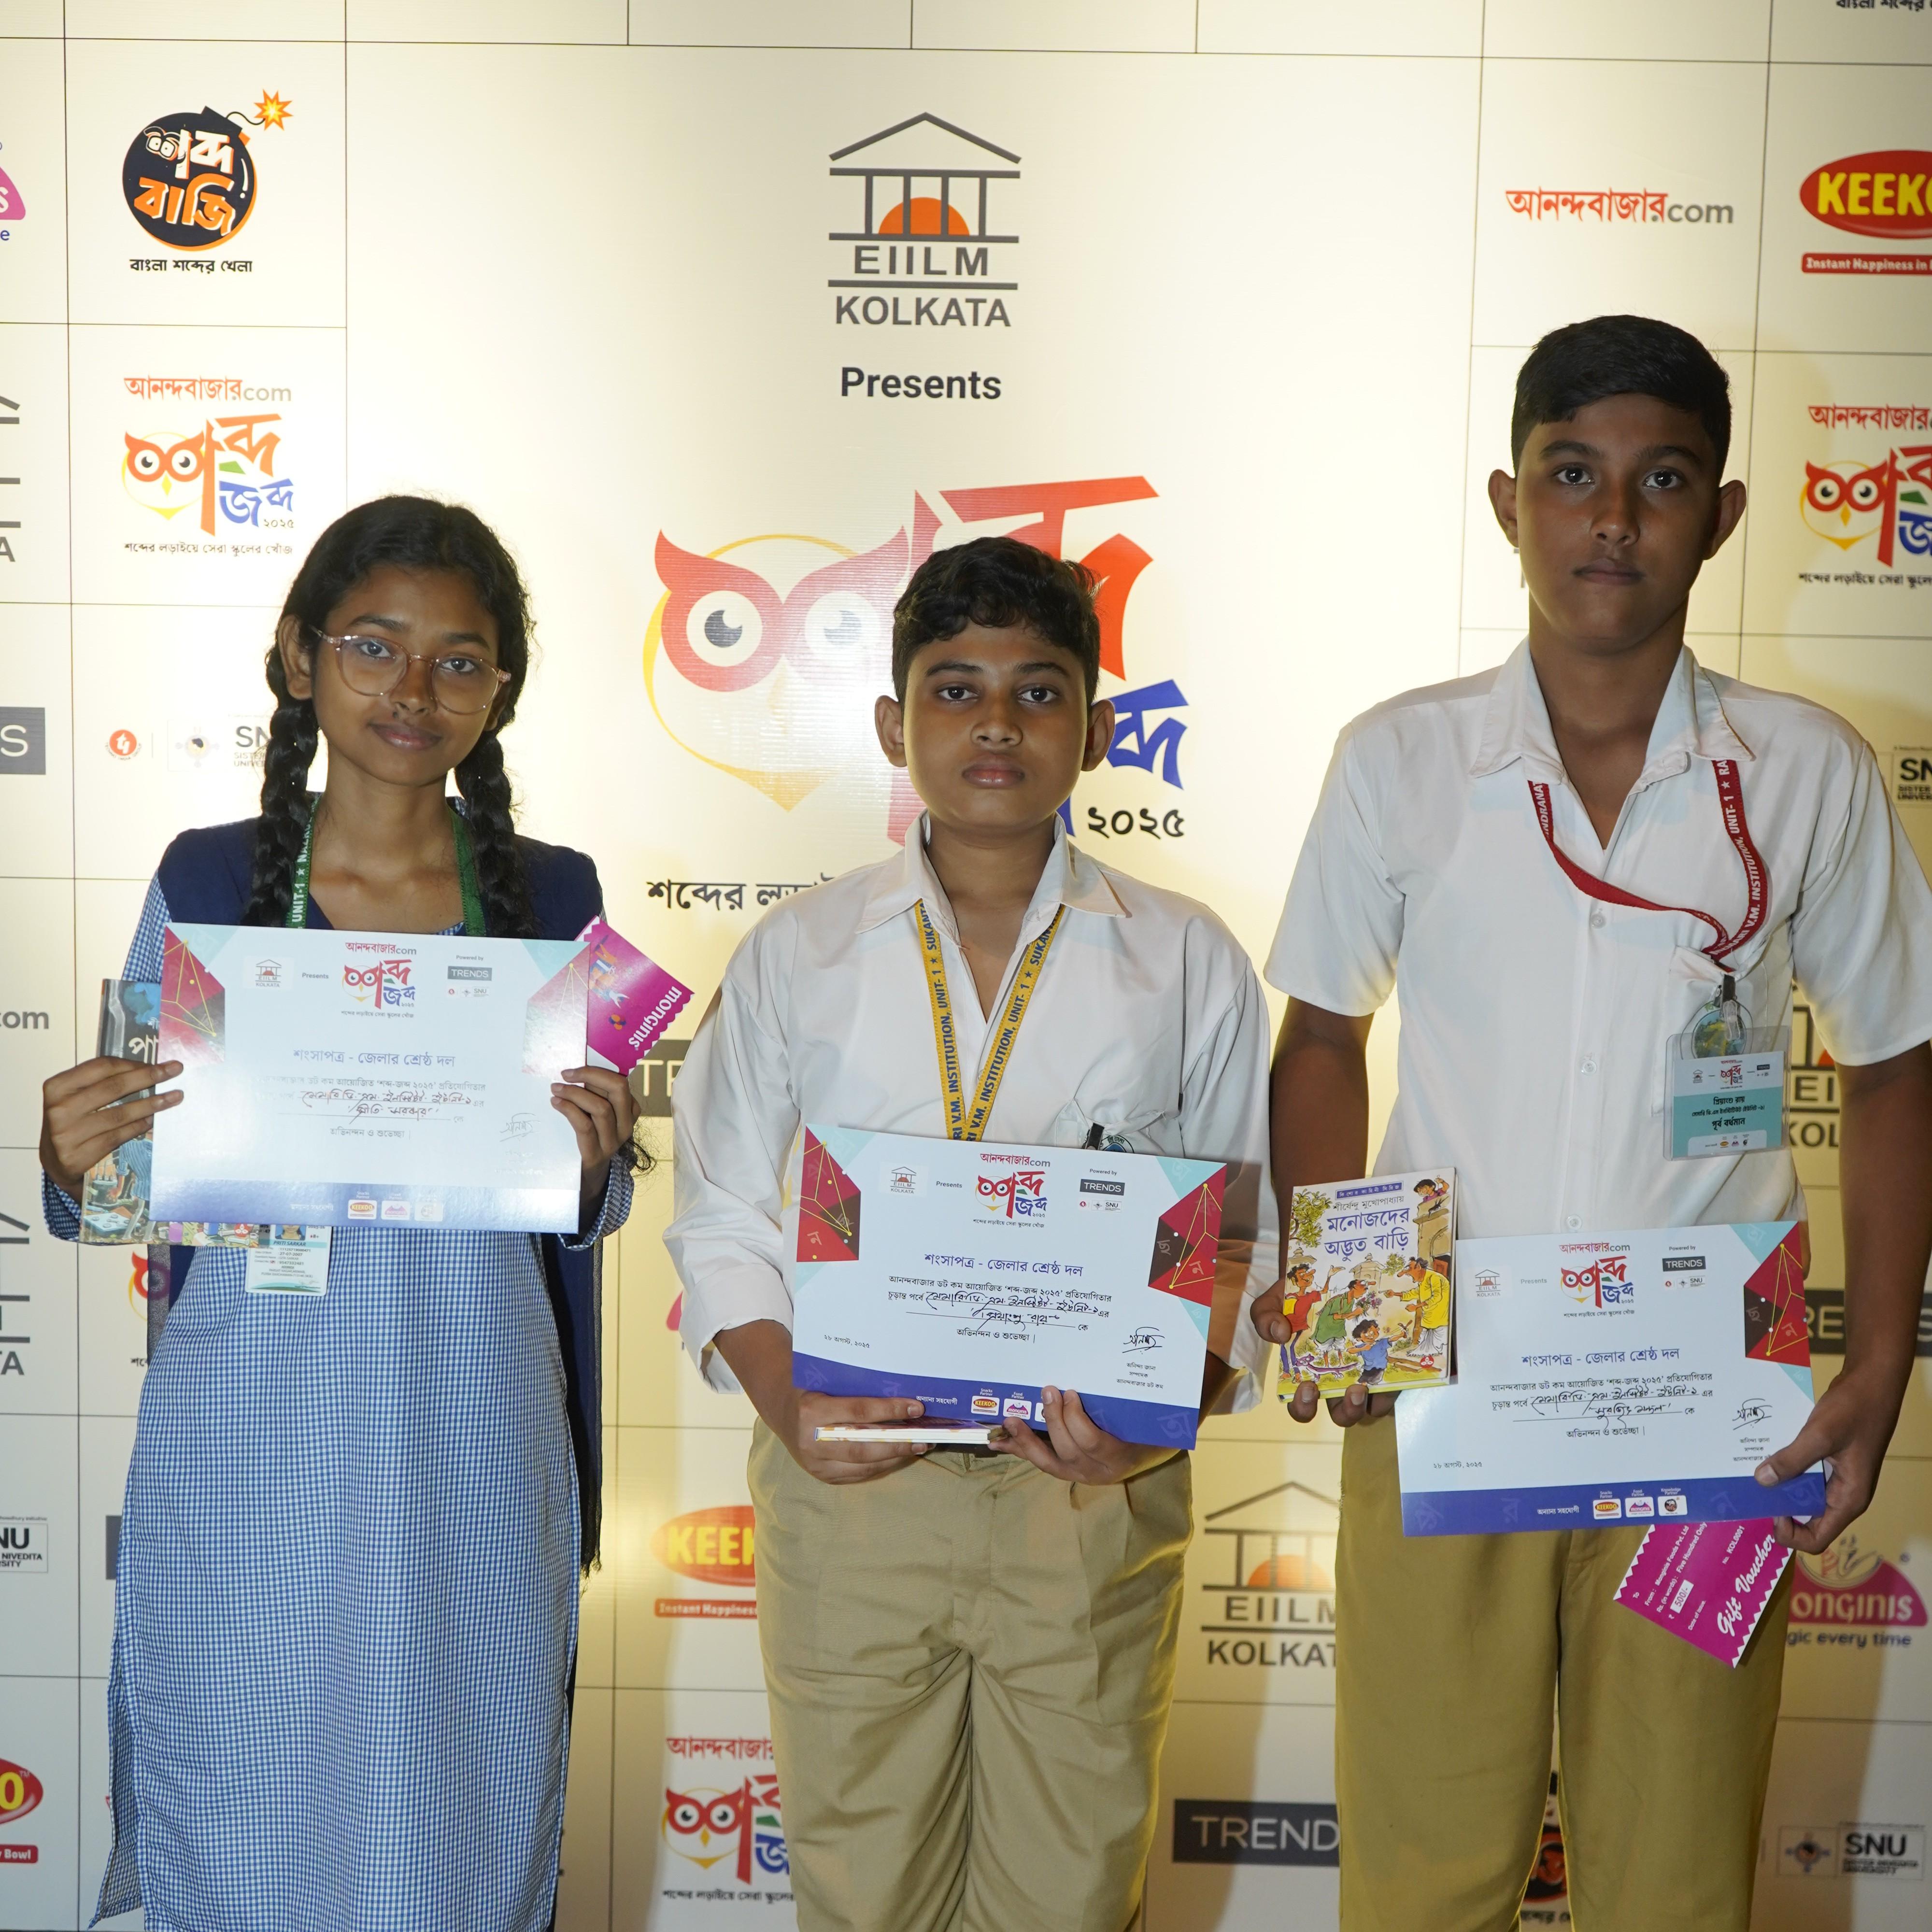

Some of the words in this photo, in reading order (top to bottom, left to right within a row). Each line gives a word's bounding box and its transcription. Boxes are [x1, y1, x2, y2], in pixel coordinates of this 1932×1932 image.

[129, 259, 167, 271] বাংলা
[173, 259, 215, 274] শব্দের
[221, 260, 253, 273] খেলা
[854, 245, 988, 276] EIILM
[1806, 257, 1850, 269] Instant
[1853, 258, 1914, 272] Happiness
[836, 296, 1011, 327] KOLKATA
[841, 367, 1002, 399] Presents
[124, 542, 155, 553] শব্দের
[203, 543, 227, 554] সেরা
[1087, 807, 1185, 839] ২০২৫
[646, 879, 747, 910] শব্দের
[451, 969, 489, 979] TRENDS
[628, 986, 682, 1051] monginis
[293, 1049, 345, 1063] শংসাপত্র
[358, 1052, 400, 1065] জেলার
[404, 1051, 433, 1066] শ্রেষ্ঠ
[437, 1056, 455, 1067] দল
[940, 1012, 959, 1093] INSTITUTION,
[969, 1106, 988, 1129] V.M.
[980, 1024, 1018, 1102] INSTITUTION,
[951, 1097, 962, 1124] V.M.
[936, 1180, 963, 1189] Presents
[1083, 1181, 1122, 1193] TRENDS
[1327, 1208, 1410, 1232] মনোজদের
[1373, 1227, 1409, 1250] বাড়ি
[924, 1254, 975, 1269] শংসাপত্র
[988, 1260, 1029, 1272] জেলার
[1032, 1261, 1061, 1274] শ্রেষ্ঠ
[1065, 1264, 1083, 1277] দল
[1666, 1259, 1703, 1269] TRENDS
[889, 1276, 935, 1287] আনন্দবাজার
[937, 1279, 948, 1287] ডট
[966, 1282, 1003, 1292] আয়োজিত
[1065, 1290, 1112, 1303] প্রতিযোগিতার
[909, 1293, 925, 1301] পর্বে
[957, 1328, 990, 1337] অভিনন্দন
[1002, 1333, 1030, 1341] শুভেচ্ছা
[1521, 1354, 1573, 1367] শংসাপত্র
[1586, 1351, 1626, 1364] জেলার
[1630, 1346, 1658, 1362] শ্রেষ্ঠ
[1662, 1349, 1679, 1360] দল
[1490, 1383, 1536, 1392] আনন্দবাজার
[1538, 1380, 1550, 1390] ডট
[1567, 1378, 1605, 1388] আয়োজিত
[1666, 1372, 1713, 1383] প্রতিযোগিতার
[1566, 1428, 1600, 1438] অভিনন্দন
[1612, 1427, 1639, 1436] শুভেচ্ছা
[1, 1552, 43, 1561] NIVEDITA
[1676, 1559, 1686, 1573] Five
[1683, 1534, 1700, 1561] Hundred
[1696, 1522, 1708, 1536] Only
[1645, 1591, 1655, 1606] From
[1655, 1562, 1671, 1586] Monginis
[1667, 1546, 1679, 1563] Foods
[1717, 1596, 1743, 1637] Gift
[1735, 1534, 1776, 1593] Voucher
[659, 1603, 701, 1615] Instant
[1817, 1632, 1868, 1648] every
[1873, 1629, 1911, 1645] time
[4, 1848, 31, 1860] Bowl
[1845, 1832, 1906, 1856] SNU
